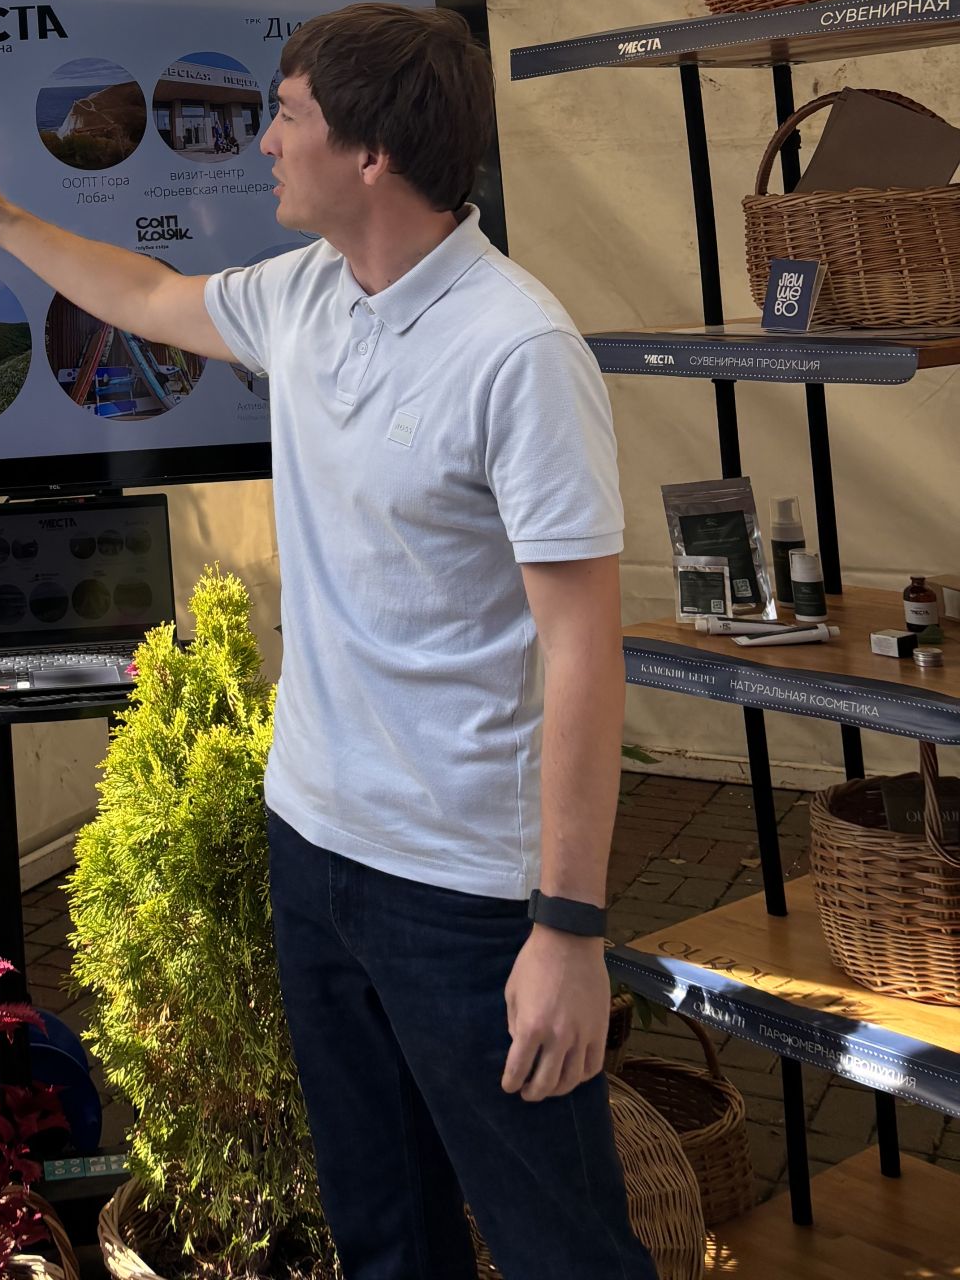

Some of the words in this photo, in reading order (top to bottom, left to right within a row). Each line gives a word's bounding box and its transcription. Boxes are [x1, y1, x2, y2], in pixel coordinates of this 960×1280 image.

[263, 17, 302, 42] Ди
[618, 38, 662, 55] МЕСТА
[61, 176, 99, 189] ООПТ
[101, 175, 130, 189] Гора
[169, 167, 245, 182] визит-центр
[76, 191, 115, 205] Лобач
[143, 183, 219, 199] «Юрьевская
[221, 181, 275, 195] пещера»
[689, 355, 754, 368] СУВЕНИРНАЯ
[756, 358, 821, 371] ПРОДУКЦИЯ
[730, 679, 807, 703] НАТУРАЛЬНАЯ
[809, 694, 880, 717] КОСМЕТИКА
[759, 1024, 843, 1063] ПАРФЮМЕРНАЯ
[845, 1053, 917, 1089] ПРОДУКЦИЯ
